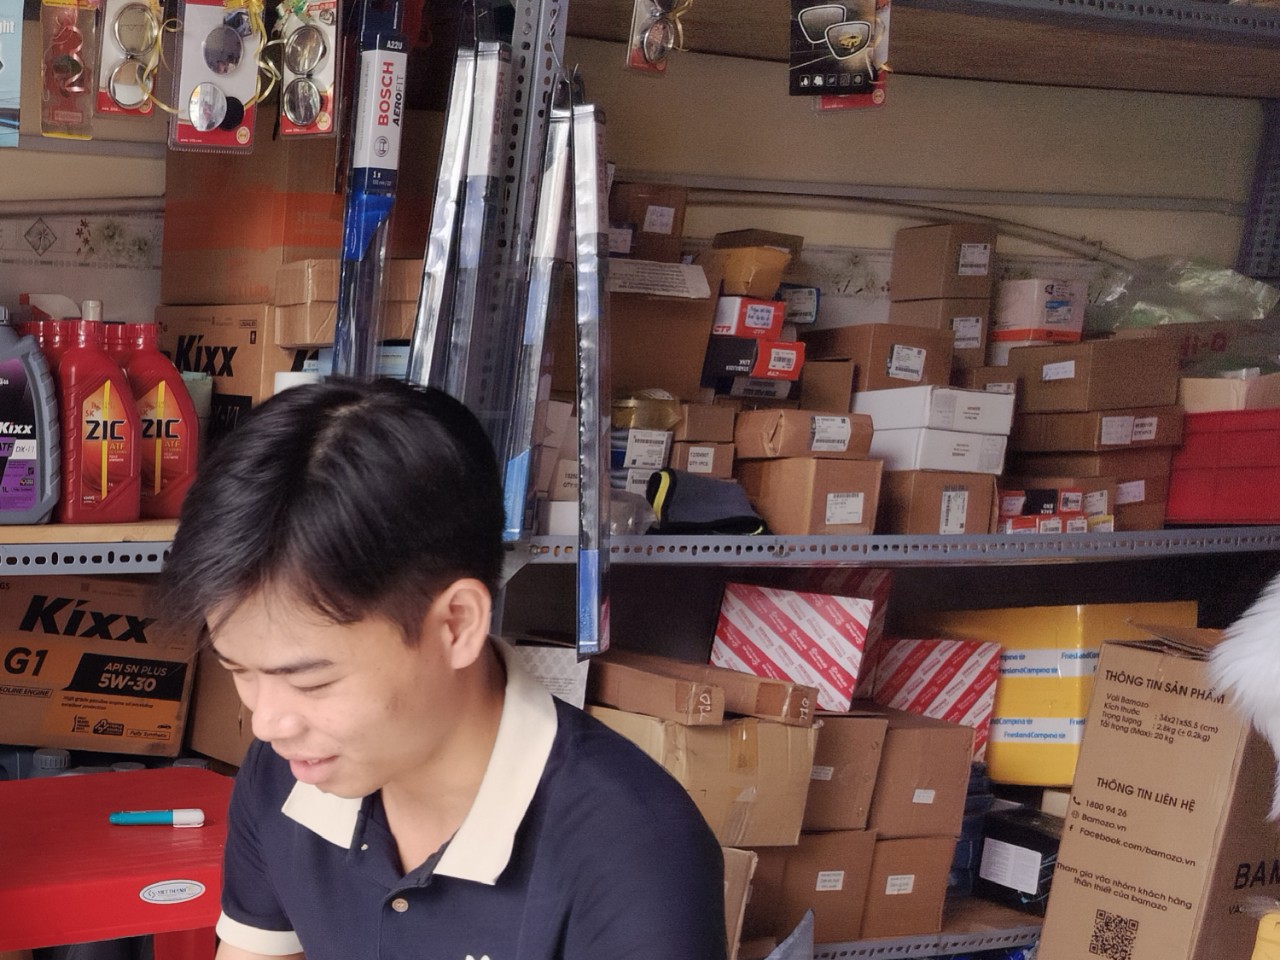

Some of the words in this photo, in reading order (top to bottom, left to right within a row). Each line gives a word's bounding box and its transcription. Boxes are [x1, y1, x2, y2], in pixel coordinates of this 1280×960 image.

[377, 61, 394, 126] BOSCH
[392, 74, 405, 127] AEROFIT
[174, 334, 238, 378] Kixx
[84, 419, 126, 441] ZIC
[141, 418, 183, 439] ZIC
[109, 442, 125, 450] ATF
[0, 582, 10, 590] GS
[18, 594, 158, 644] Kixx
[4, 646, 48, 677] G1
[104, 662, 123, 673] API
[124, 664, 139, 674] SN
[138, 665, 168, 677] PLUS
[23, 688, 50, 696] ENGINE
[98, 673, 157, 692] 5W-30
[1105, 669, 1144, 687] THÔNG
[1146, 678, 1162, 691] TIN
[1164, 680, 1188, 696] SẢN
[1106, 692, 1120, 702] Vali
[1120, 695, 1150, 709] Bamozo
[1130, 726, 1153, 738] (Max):
[1164, 734, 1174, 744] kg
[1156, 723, 1177, 735] 2.8kg
[1186, 730, 1211, 743] 0.2kg)
[1158, 713, 1199, 729] 34x21x55.5
[1199, 722, 1219, 734] (cm)
[1096, 777, 1134, 796] THÔNG
[1136, 787, 1153, 801] TIN
[1154, 791, 1178, 808] LIÊN
[1180, 799, 1196, 814] HỆ
[1085, 799, 1105, 811] 1800
[1105, 805, 1116, 814] 94
[1117, 808, 1128, 818] 26
[1081, 813, 1127, 832] Bamozo.vn
[1079, 827, 1196, 867] Facebook.com/bamozo.vn
[1056, 861, 1078, 874] Tham
[1079, 868, 1093, 879] gia
[1095, 872, 1111, 884] vào
[1112, 878, 1137, 893] nhóm
[1137, 885, 1166, 901] khách
[1167, 893, 1193, 910] hàng
[1073, 875, 1093, 890] thân
[1093, 881, 1113, 895] thiết
[1113, 887, 1130, 900] của
[1130, 893, 1168, 912] bamozo
